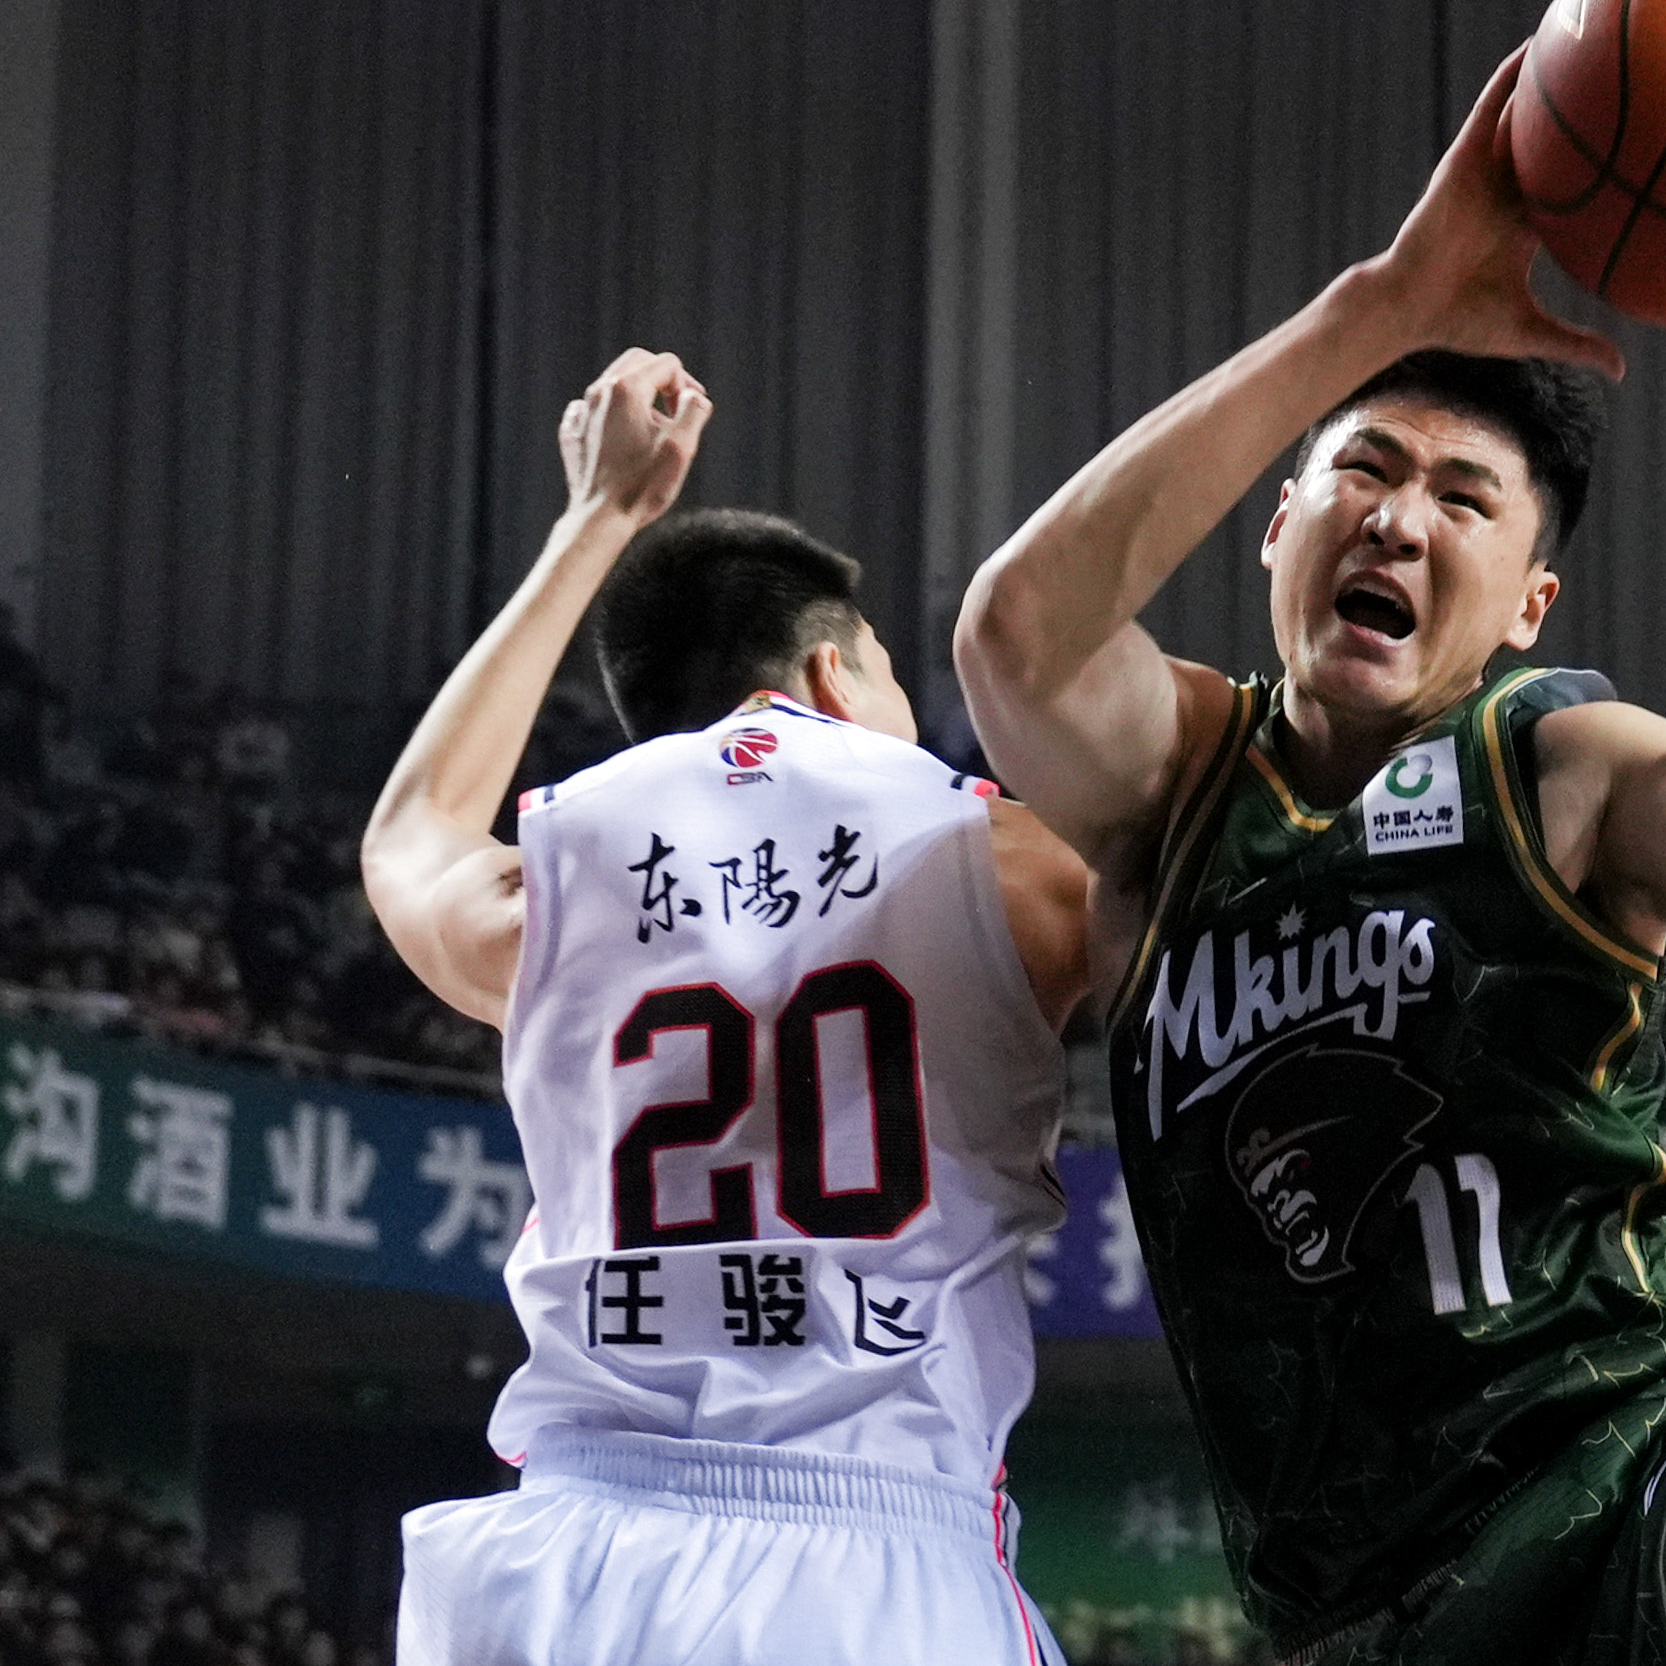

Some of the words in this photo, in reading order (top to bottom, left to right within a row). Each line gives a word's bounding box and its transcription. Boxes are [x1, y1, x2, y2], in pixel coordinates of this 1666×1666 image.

[1375, 829, 1420, 843] CHINA
[1424, 824, 1453, 837] LIFE
[611, 959, 931, 1251] 20
[1403, 1152, 1514, 1315] 11
